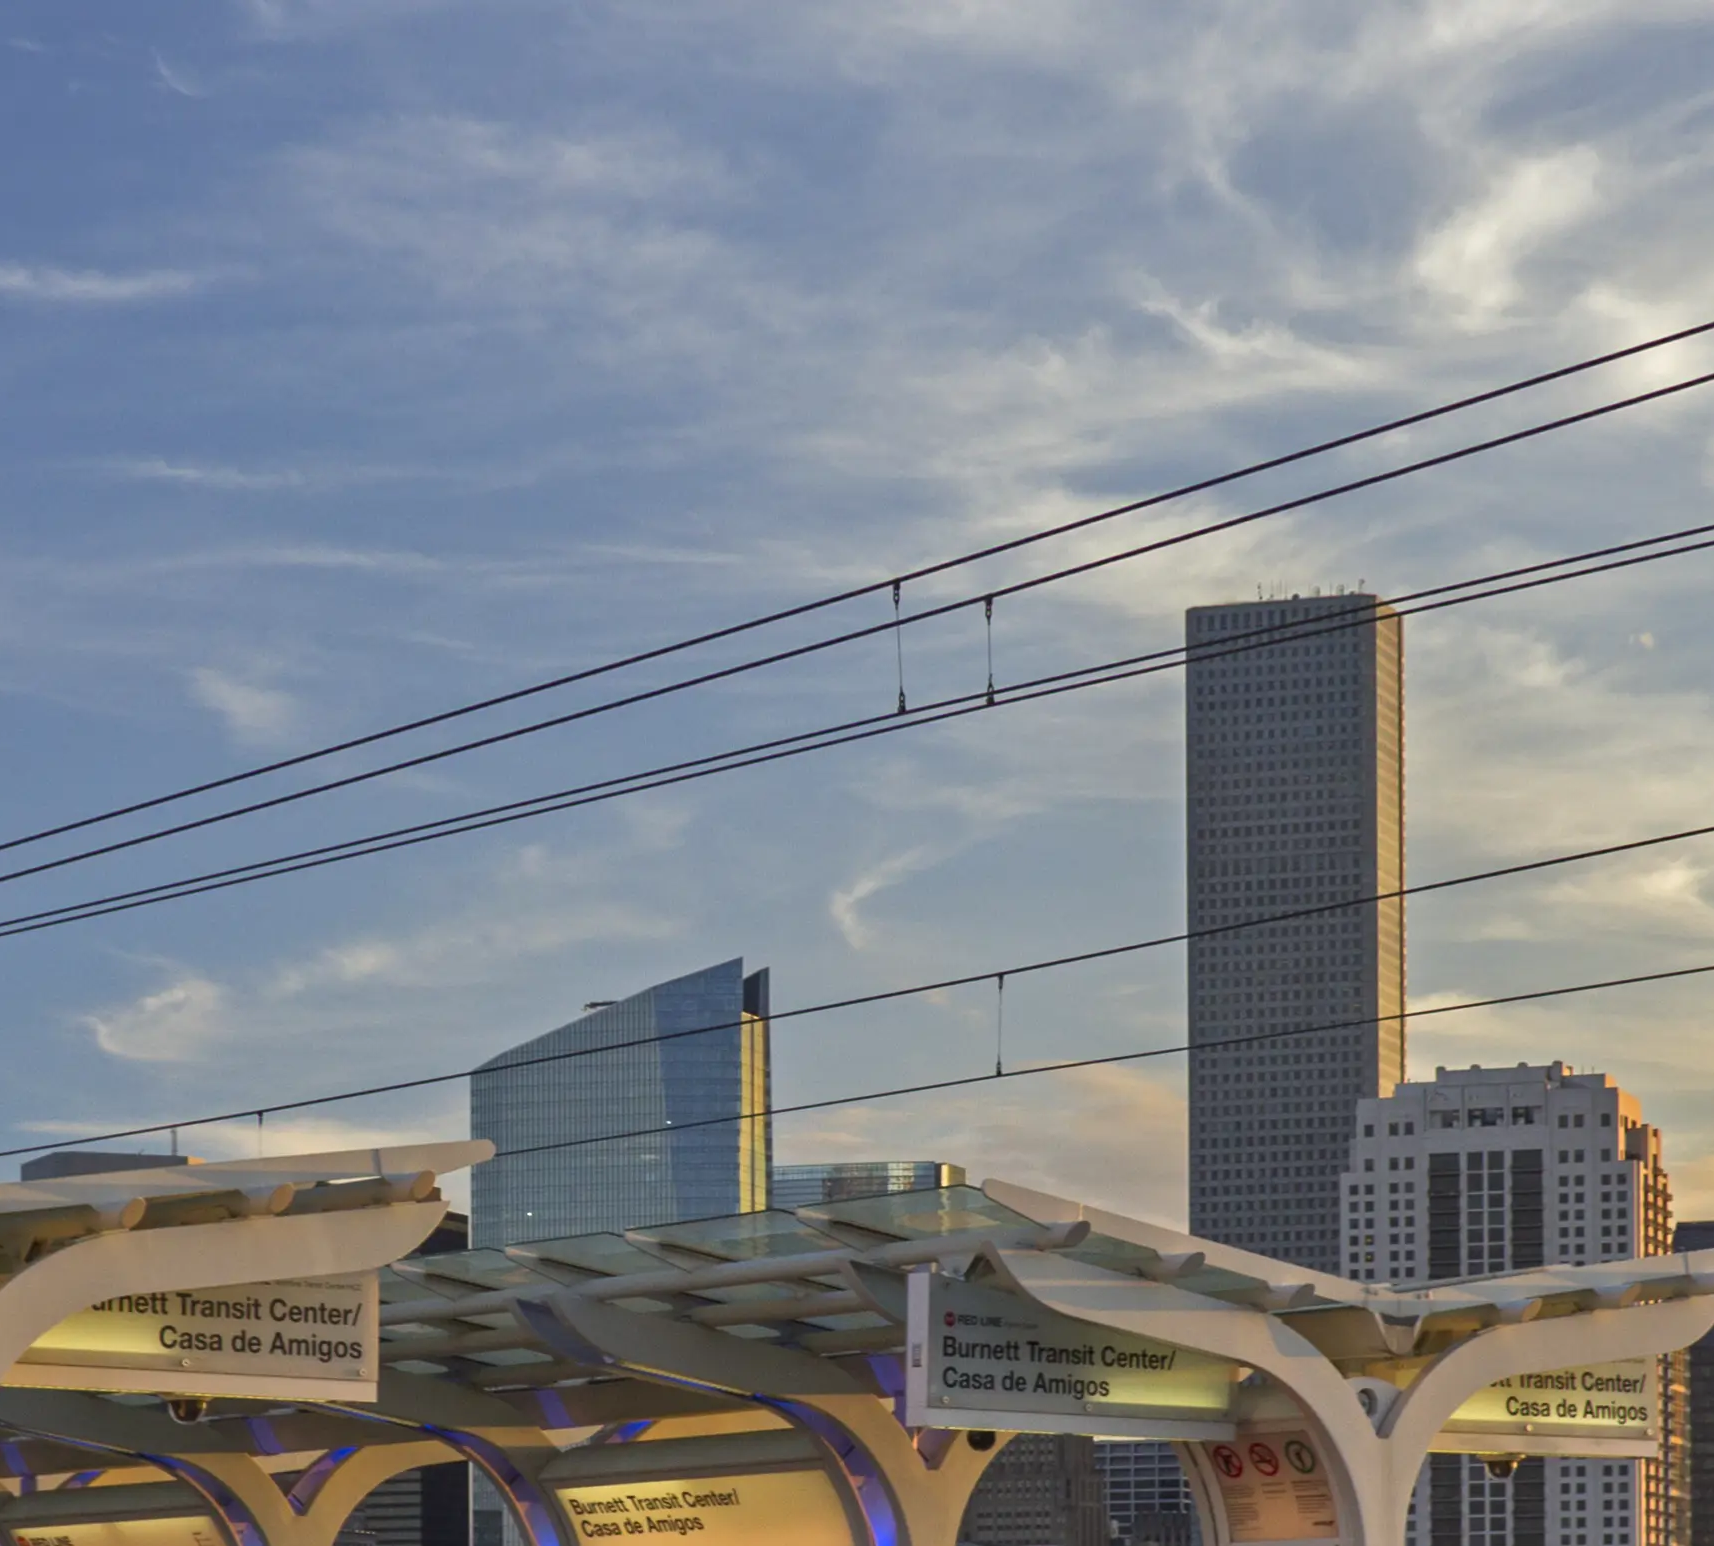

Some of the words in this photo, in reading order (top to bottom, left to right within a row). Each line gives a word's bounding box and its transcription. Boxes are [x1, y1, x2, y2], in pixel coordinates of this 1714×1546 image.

[91, 1293, 168, 1315] urnett
[175, 1292, 262, 1321] Transit
[268, 1297, 363, 1327] Center/
[957, 1314, 978, 1326] RED
[158, 1325, 224, 1351] Casa
[231, 1329, 262, 1354] de
[269, 1331, 363, 1363] Amigos
[942, 1335, 1020, 1362] Burnett
[1026, 1340, 1095, 1366] Transit
[1100, 1345, 1177, 1371] Center/
[942, 1366, 995, 1391] Casa
[1001, 1370, 1027, 1392] de
[1033, 1373, 1110, 1400] Amigos
[1519, 1371, 1577, 1391] Transit
[1580, 1371, 1647, 1394] Center/
[1505, 1396, 1551, 1418] Casa
[1555, 1398, 1578, 1419] de
[1583, 1400, 1649, 1425] Amigos
[568, 1498, 629, 1515] Burnett
[626, 1493, 683, 1512] Transit
[681, 1487, 741, 1508] Center/
[581, 1519, 622, 1538] Casa
[624, 1517, 644, 1535] de
[646, 1514, 705, 1536] Amigos
